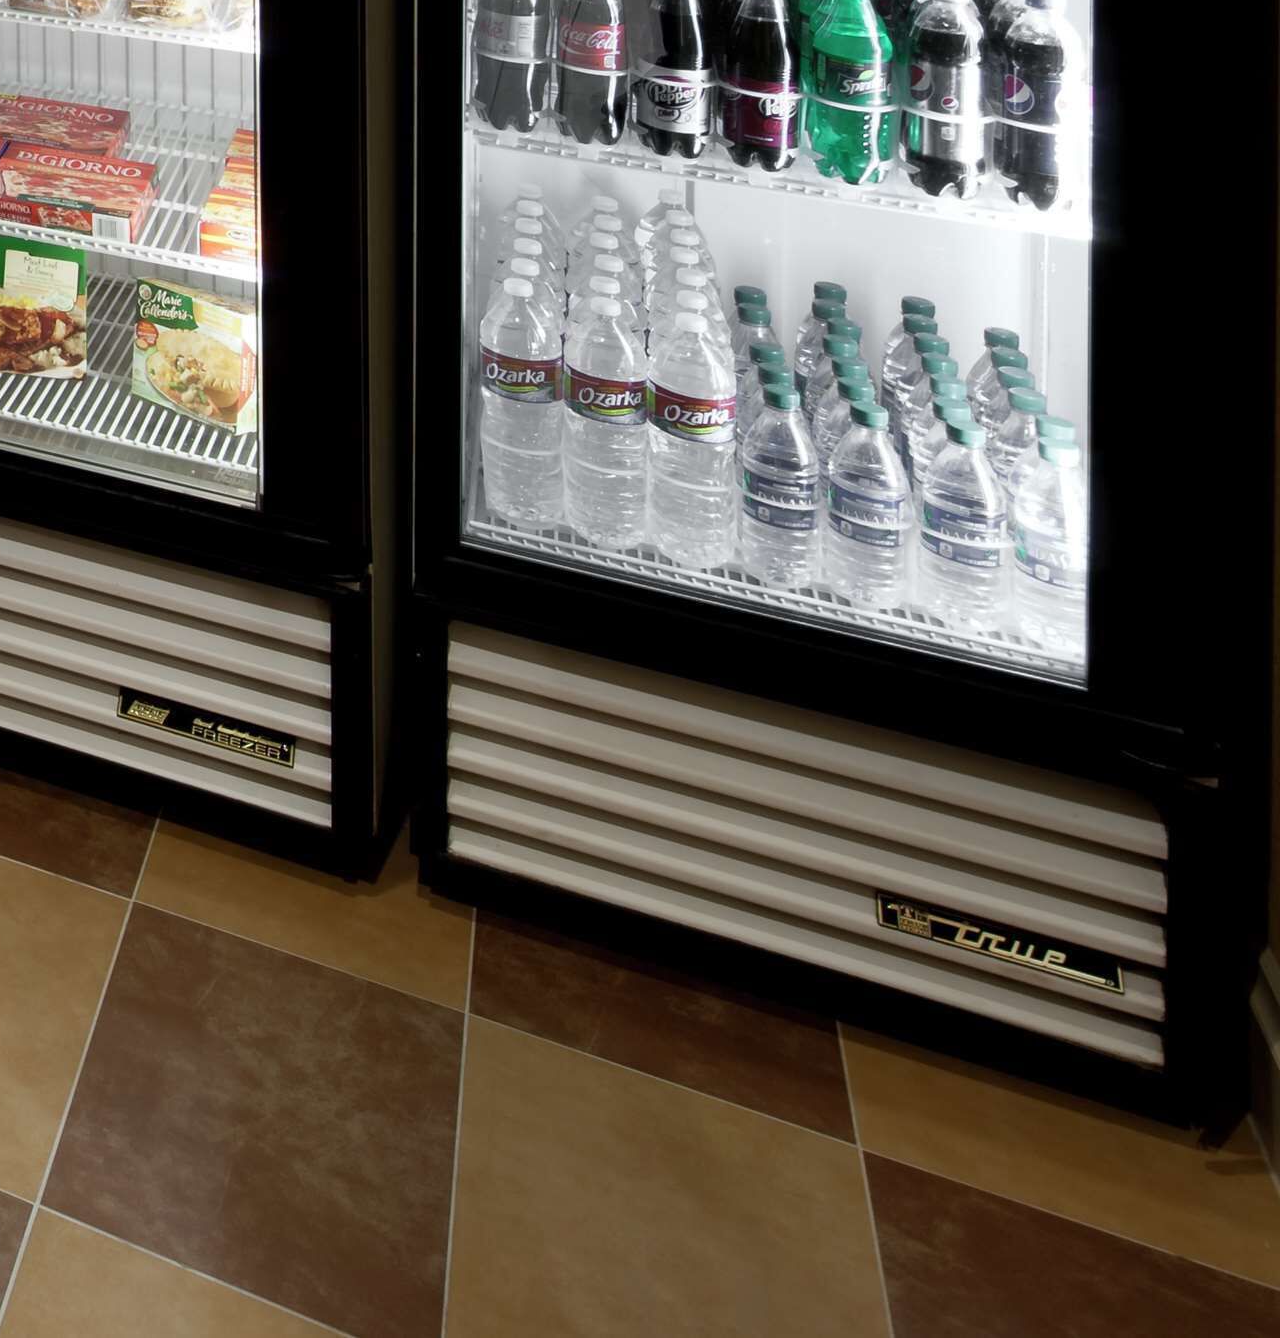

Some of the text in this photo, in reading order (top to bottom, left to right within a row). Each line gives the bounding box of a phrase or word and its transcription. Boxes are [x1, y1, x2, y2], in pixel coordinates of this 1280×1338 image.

[654, 86, 697, 104] Pepper
[151, 289, 183, 308] Marie
[138, 299, 193, 321] Callender's
[486, 363, 546, 385] Ozarka
[578, 387, 642, 408] Ozarka
[664, 404, 730, 426] Ozarka
[191, 725, 282, 760] FREEZER
